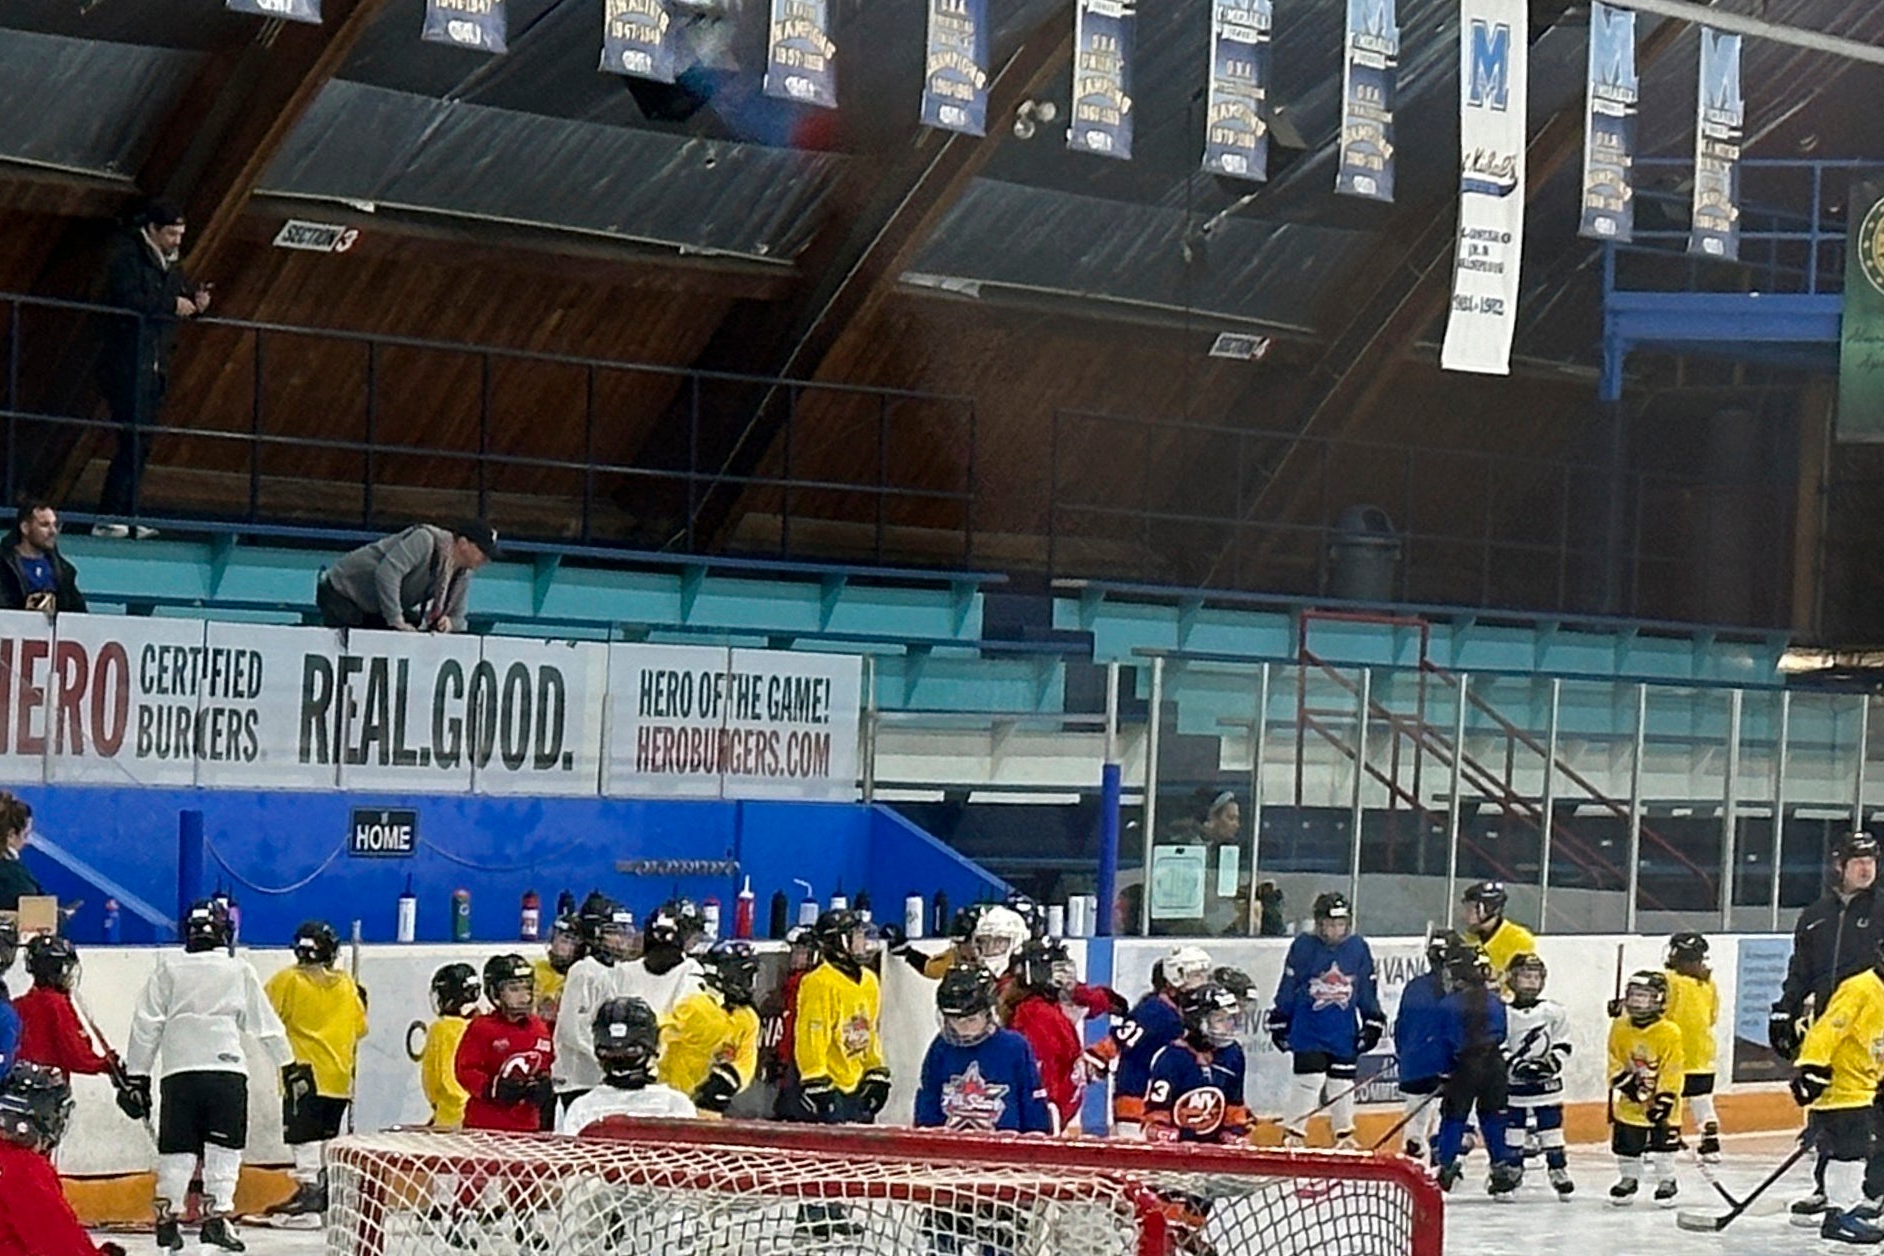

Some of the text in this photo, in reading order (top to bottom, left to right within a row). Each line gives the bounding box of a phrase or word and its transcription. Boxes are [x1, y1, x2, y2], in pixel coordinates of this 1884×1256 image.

[1467, 18, 1511, 112] M
[281, 223, 358, 252] SECTION 3
[139, 643, 263, 699] CERTIFIED
[638, 668, 693, 719] HERO
[699, 671, 725, 718] OF
[727, 673, 763, 721] THE
[767, 675, 831, 724] GAME!
[635, 725, 831, 778] HEROBURGERS.COM
[356, 824, 411, 851] HOME
[1117, 1019, 1144, 1048] 31
